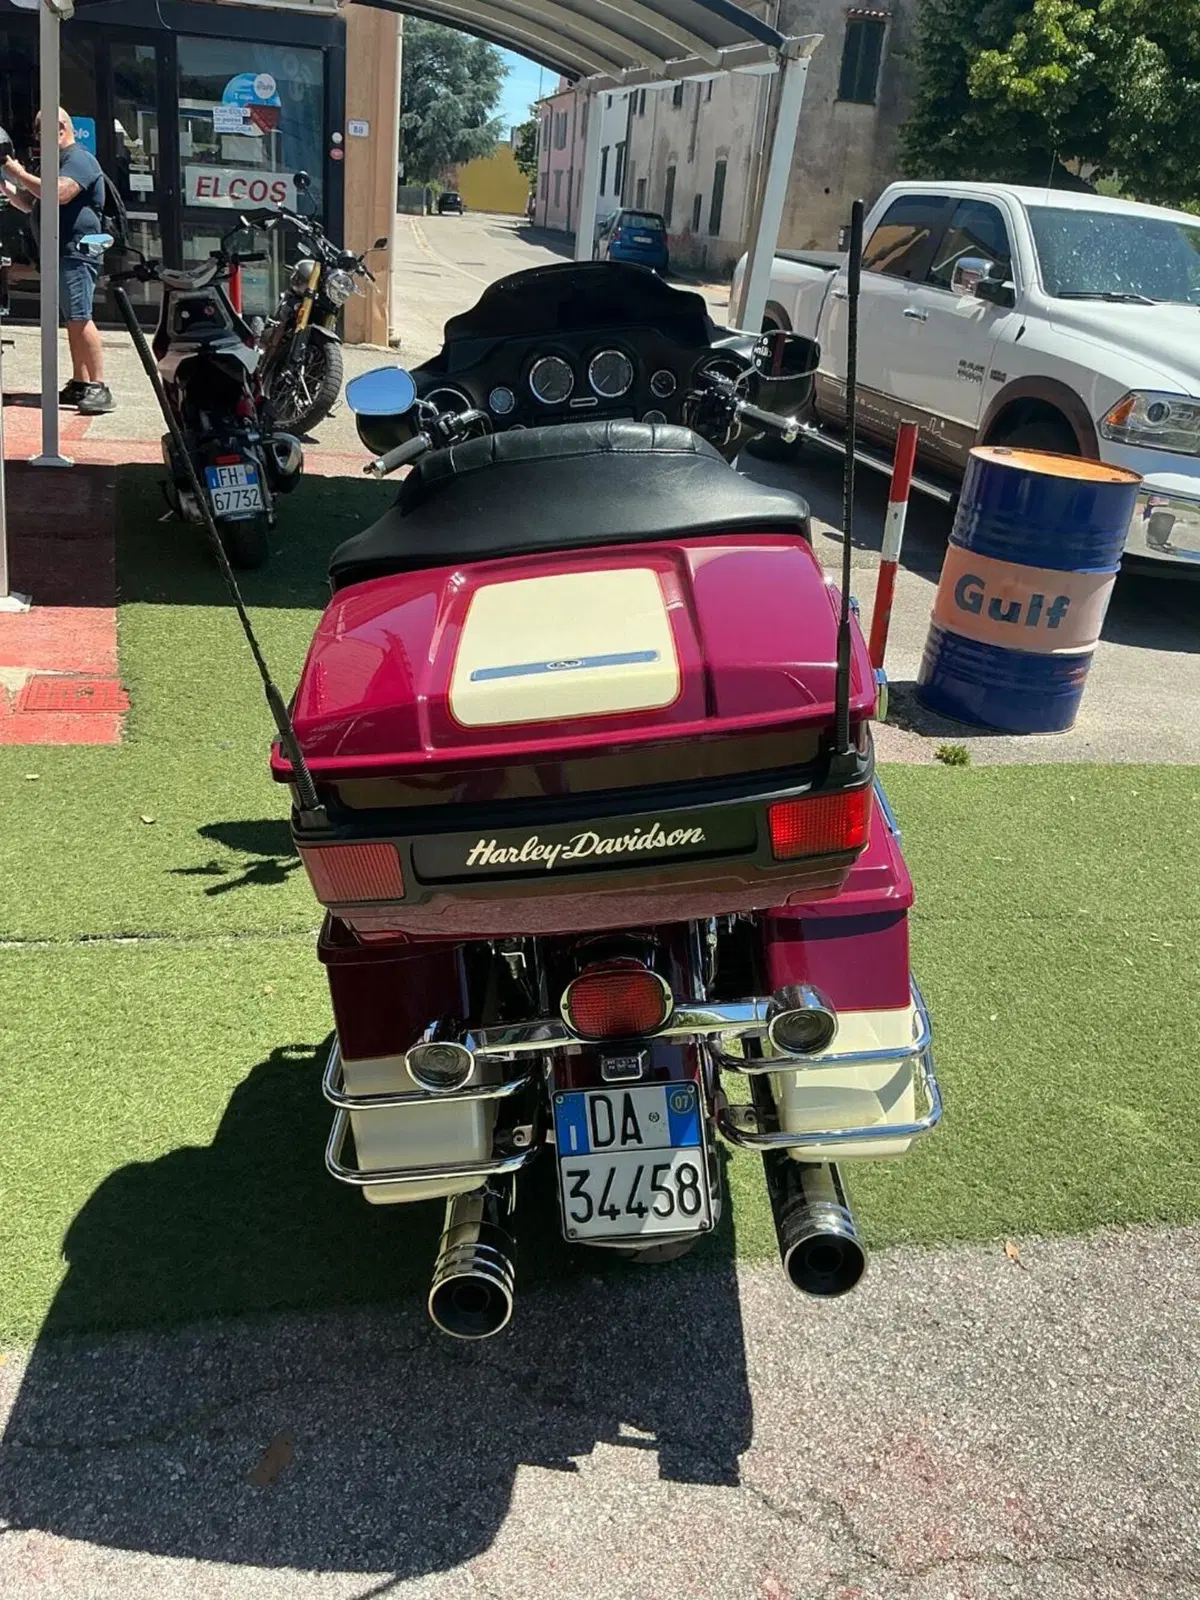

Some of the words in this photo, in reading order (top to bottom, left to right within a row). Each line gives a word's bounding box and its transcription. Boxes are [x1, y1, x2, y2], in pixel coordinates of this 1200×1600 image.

[196, 176, 287, 203] ELCOS
[219, 467, 239, 486] FH
[214, 489, 260, 511] 67732
[954, 574, 1071, 629] Gulf
[675, 1096, 689, 1110] 07
[589, 1092, 644, 1148] DA
[566, 1162, 701, 1224] 34458
